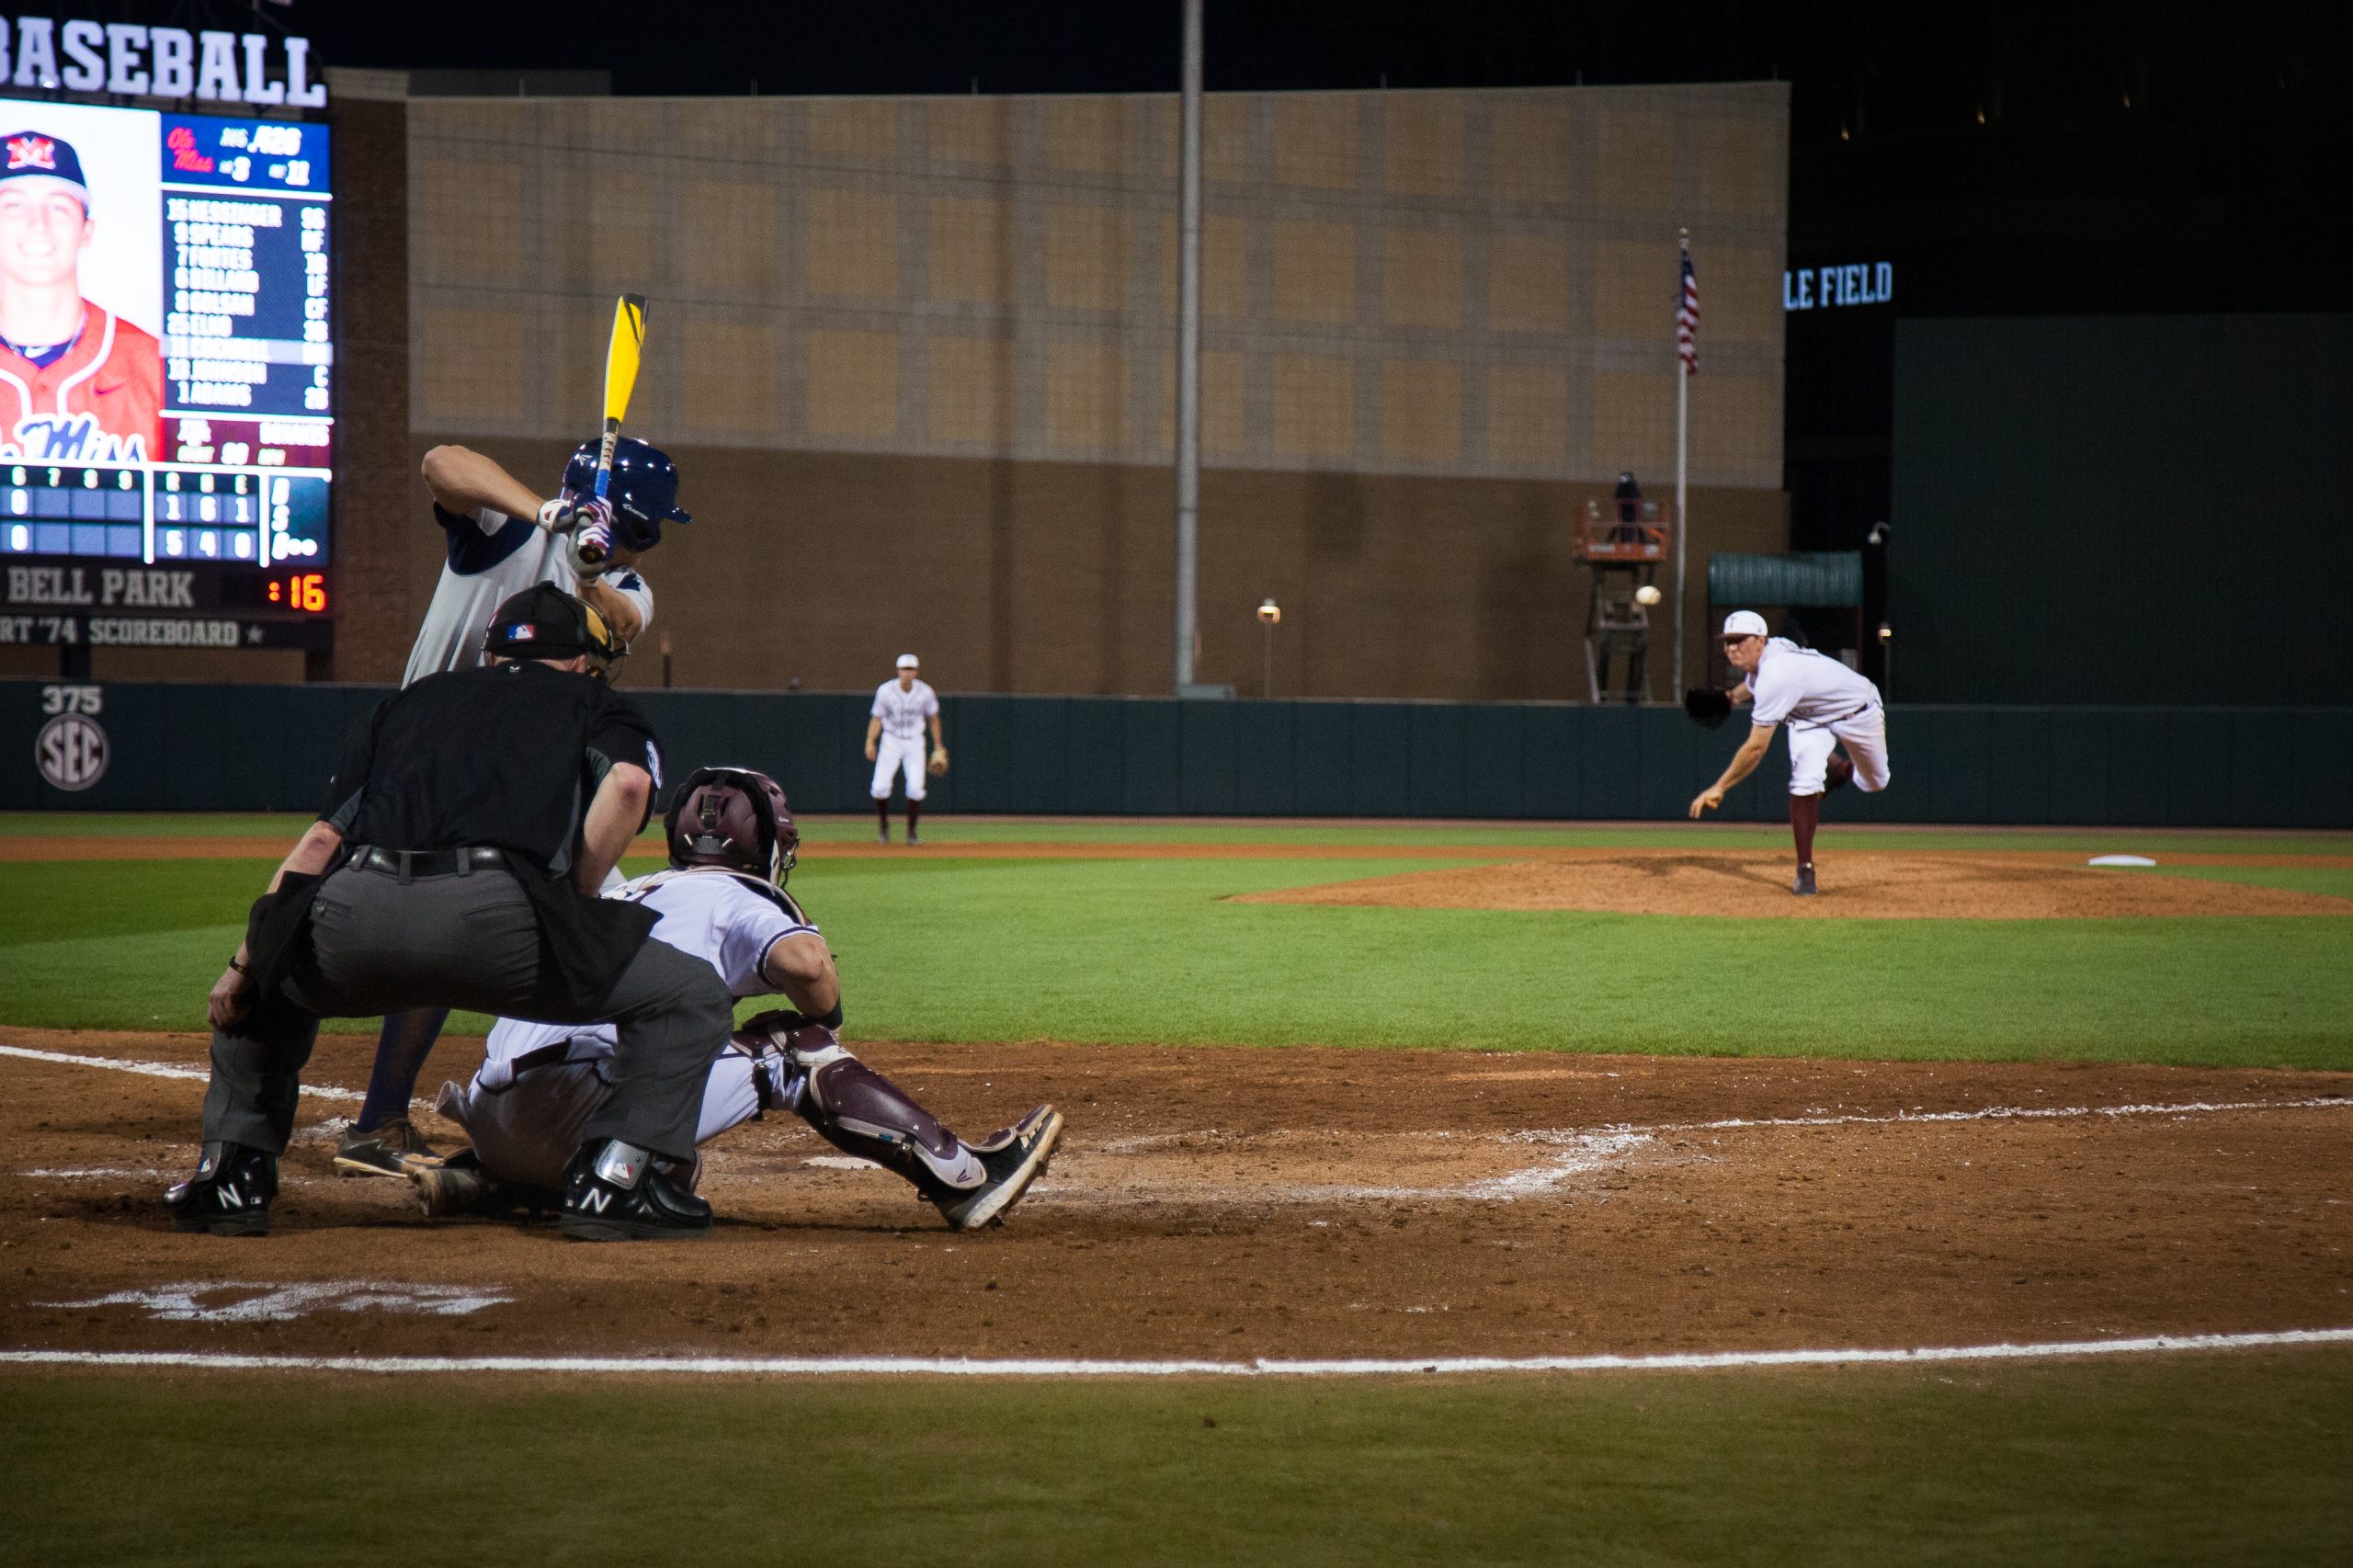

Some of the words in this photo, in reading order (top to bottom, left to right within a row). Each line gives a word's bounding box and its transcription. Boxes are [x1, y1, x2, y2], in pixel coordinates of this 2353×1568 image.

[0, 16, 327, 108] ASEBALL
[1819, 261, 1893, 308] FIELD
[48, 467, 61, 487] 7
[166, 494, 181, 520] 1
[235, 497, 250, 523] 1
[7, 566, 94, 604] BELL
[101, 569, 195, 607] PARK
[39, 617, 77, 642] '74
[89, 618, 239, 646] SCOREBOARD
[42, 685, 103, 714] 375
[42, 721, 101, 782] SEC
[217, 1184, 243, 1209] N
[580, 1187, 612, 1212] N
